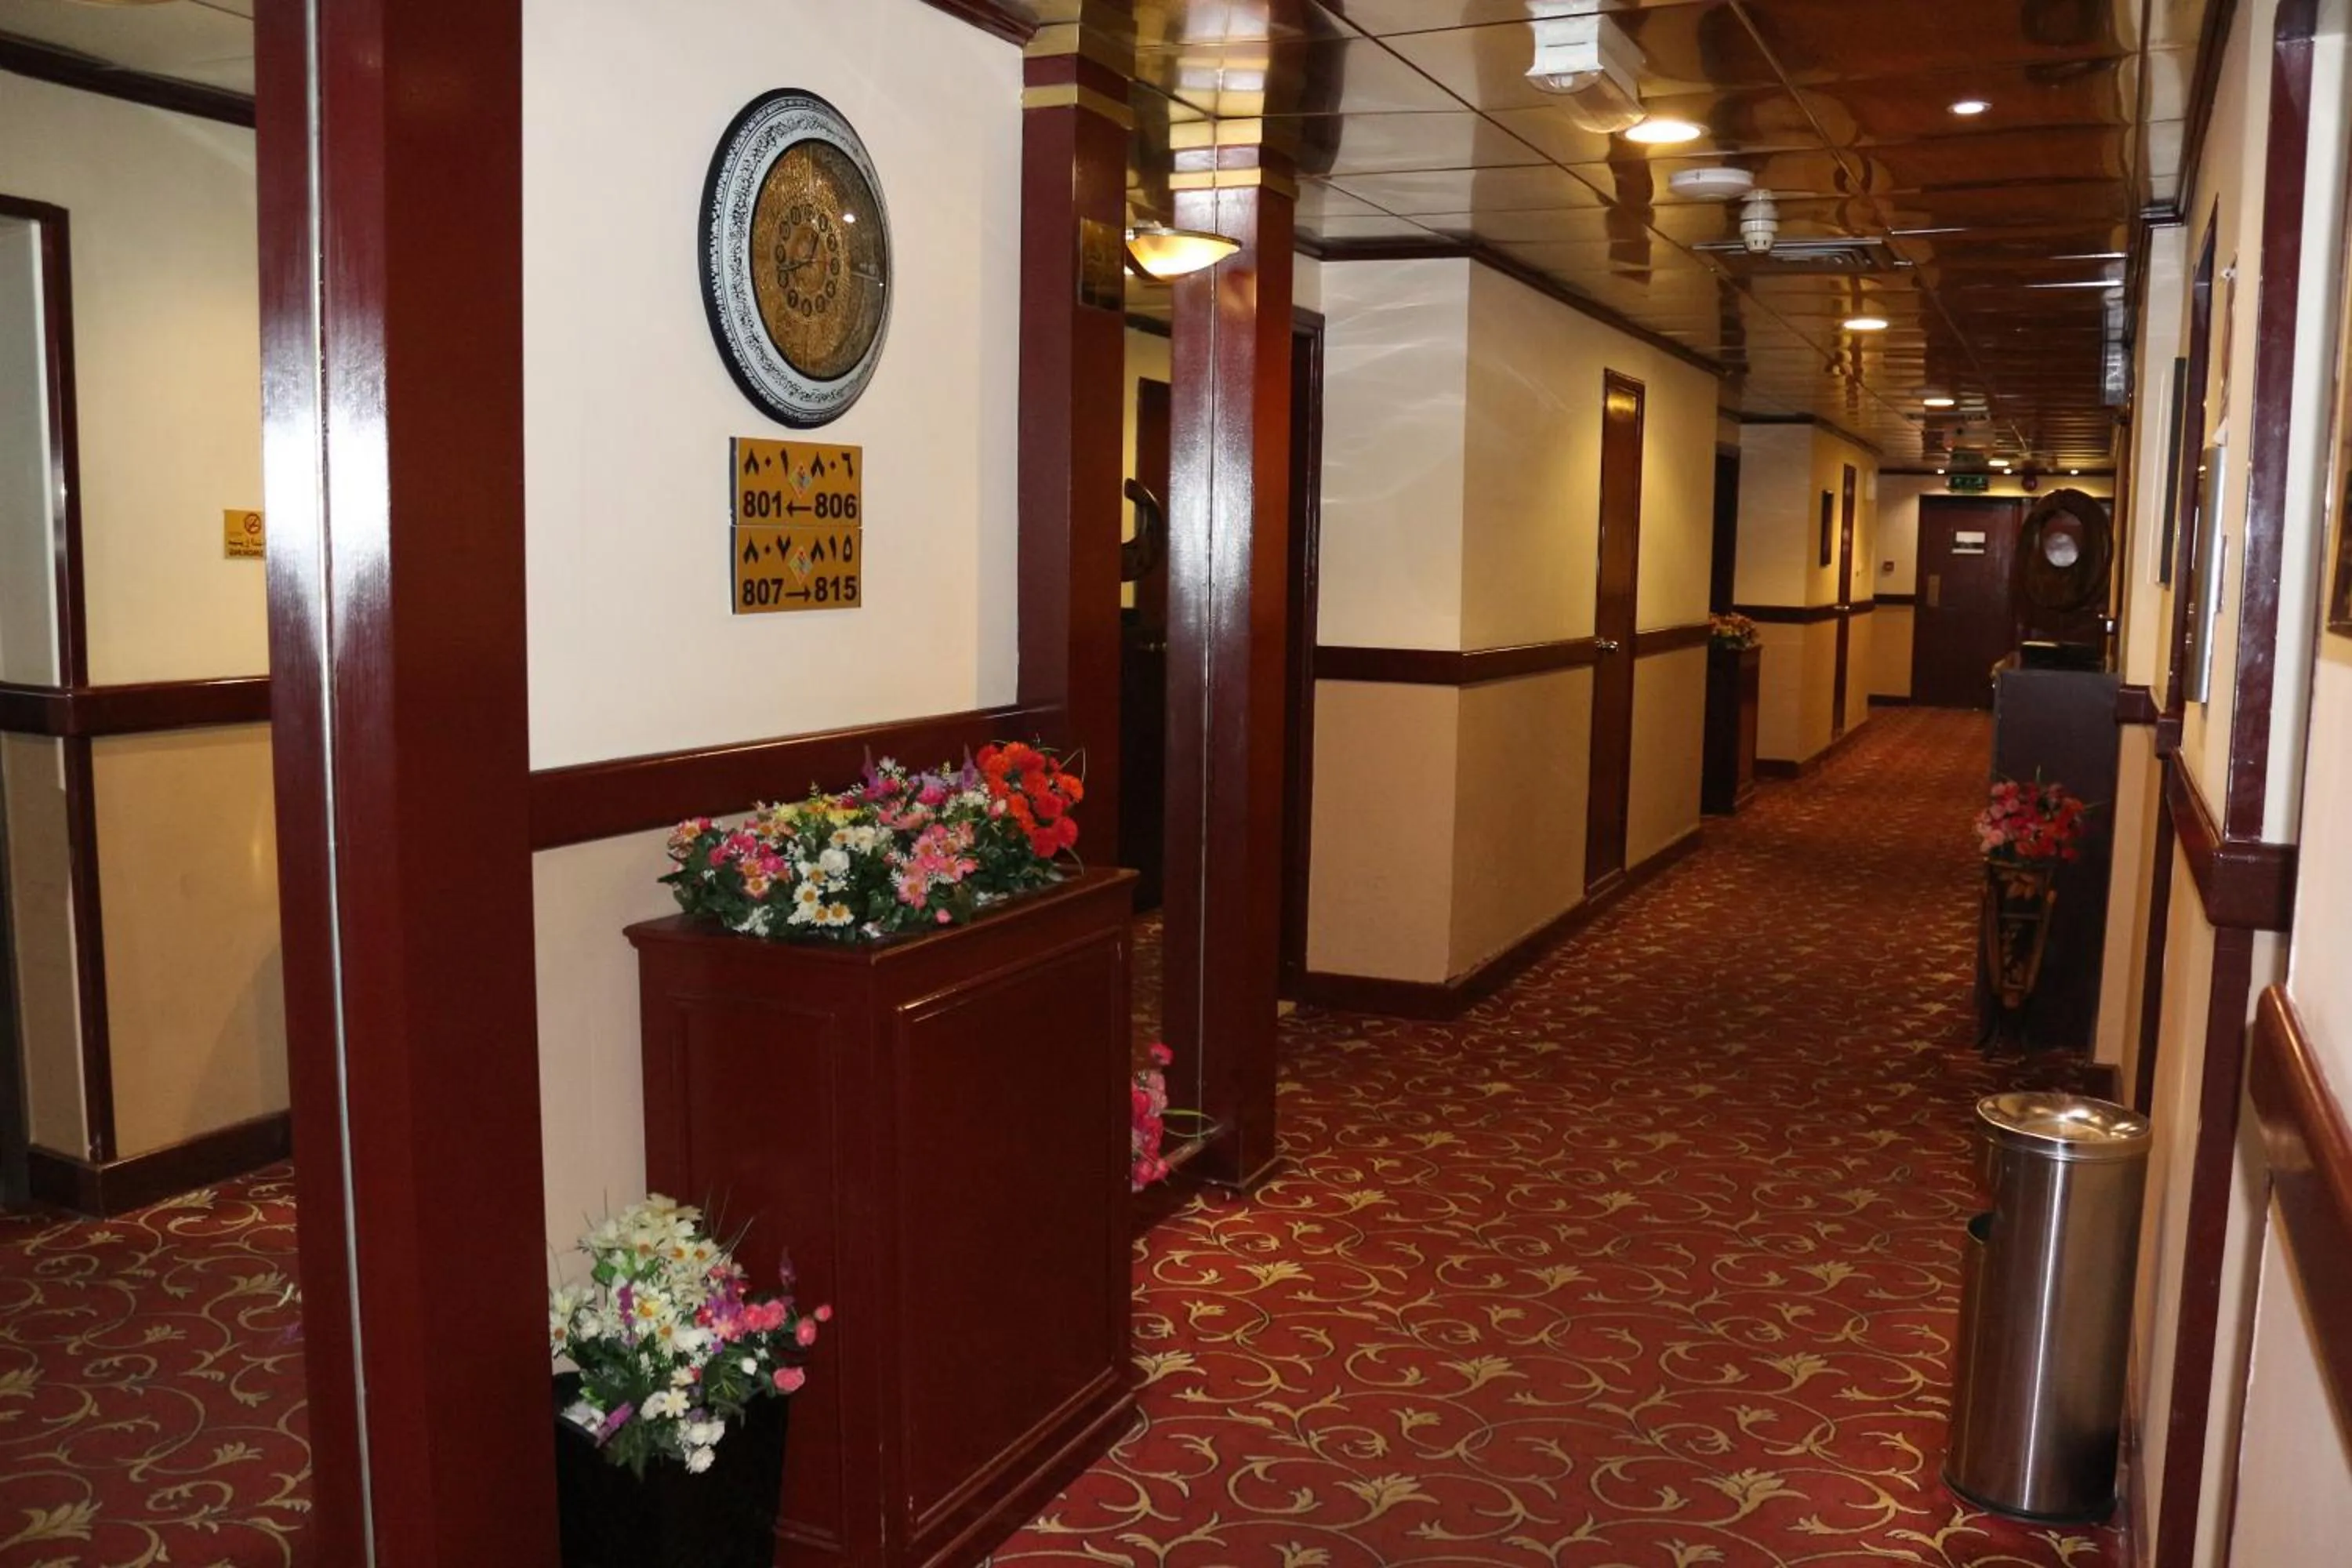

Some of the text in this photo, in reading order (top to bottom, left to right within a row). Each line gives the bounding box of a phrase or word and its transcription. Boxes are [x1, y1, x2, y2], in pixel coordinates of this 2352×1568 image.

[744, 448, 853, 480] ٨٠١ ٨٠٦
[743, 491, 857, 519] 801 806
[743, 535, 852, 564] ٨٠٧ ٨١٥
[742, 575, 857, 606] 807 815
